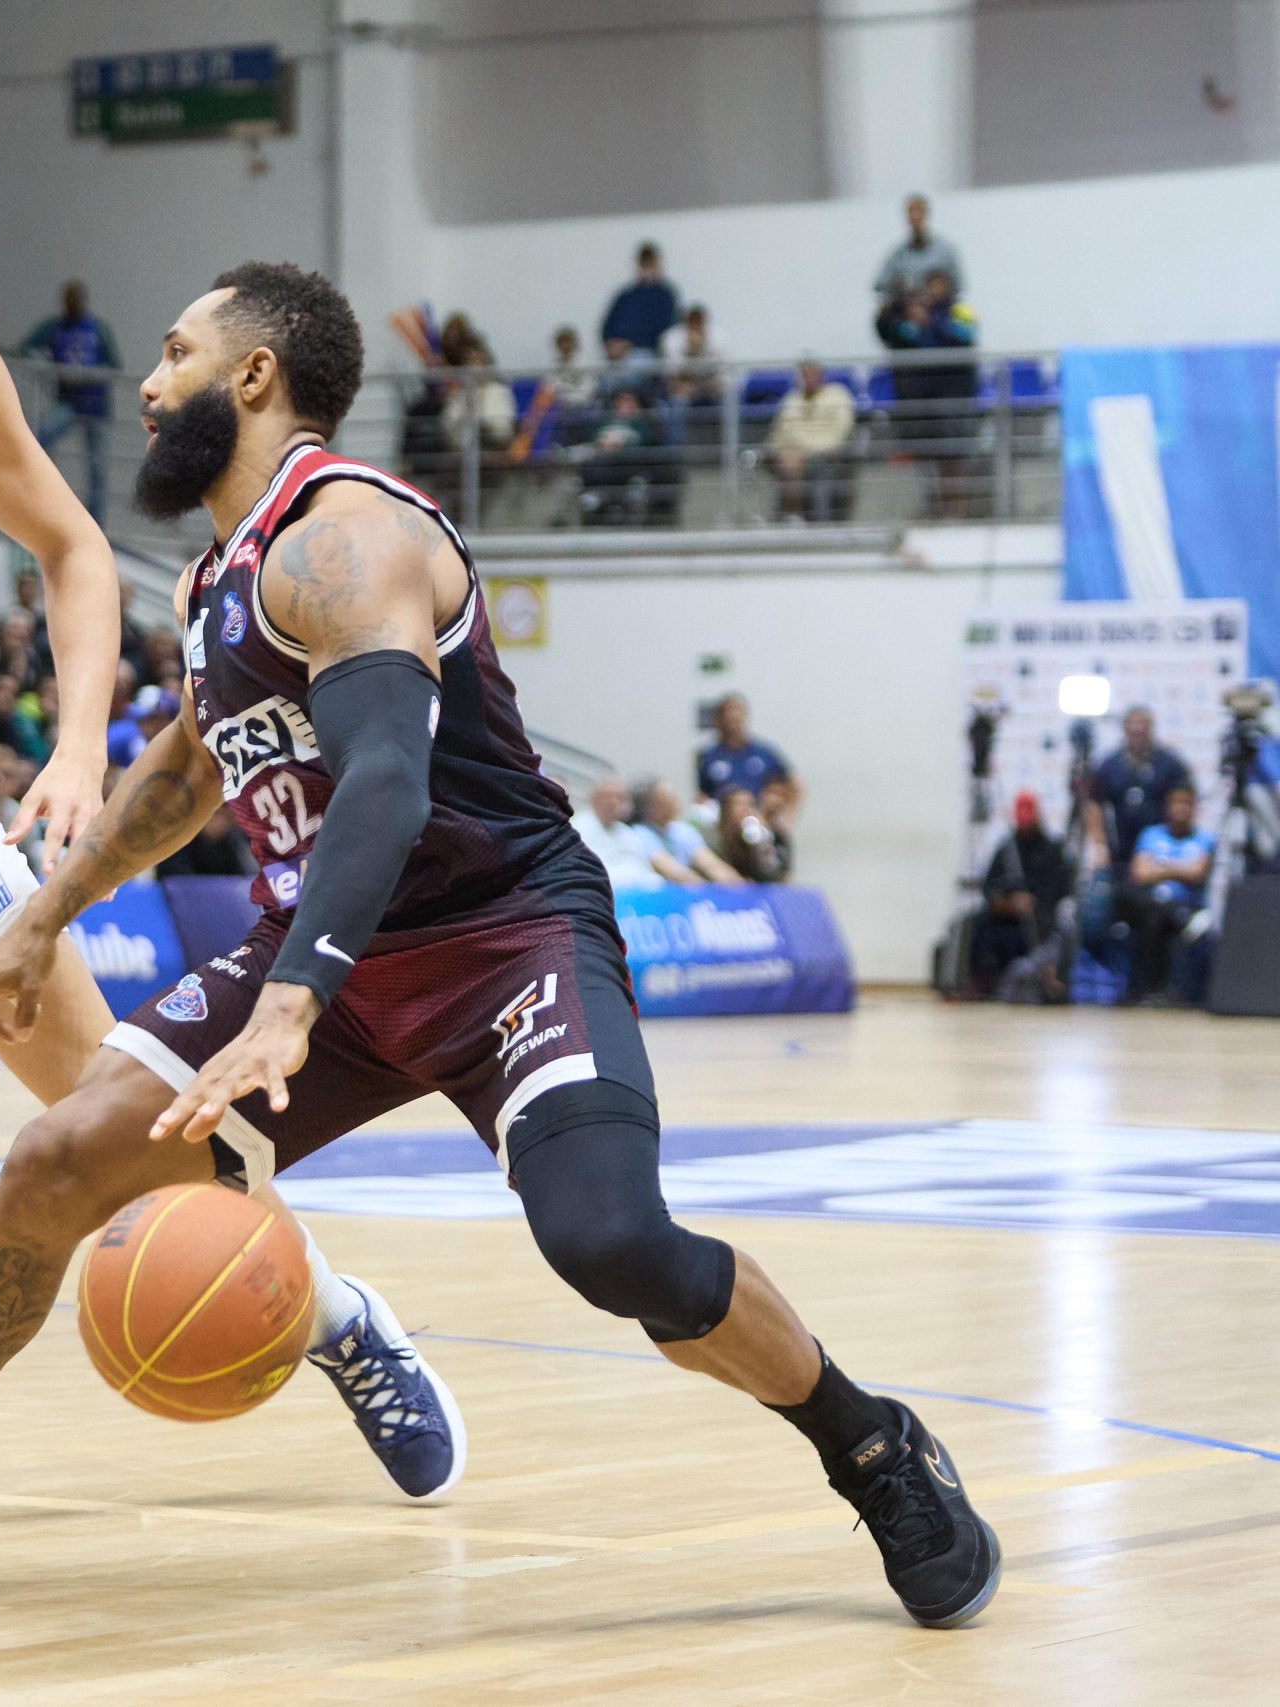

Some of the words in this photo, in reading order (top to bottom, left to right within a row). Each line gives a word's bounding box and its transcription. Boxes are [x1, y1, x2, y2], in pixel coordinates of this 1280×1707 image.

[216, 707, 296, 789] SESI
[252, 769, 325, 856] 32
[504, 1022, 568, 1079] FREEWAY
[856, 1439, 886, 1466] BOOK
